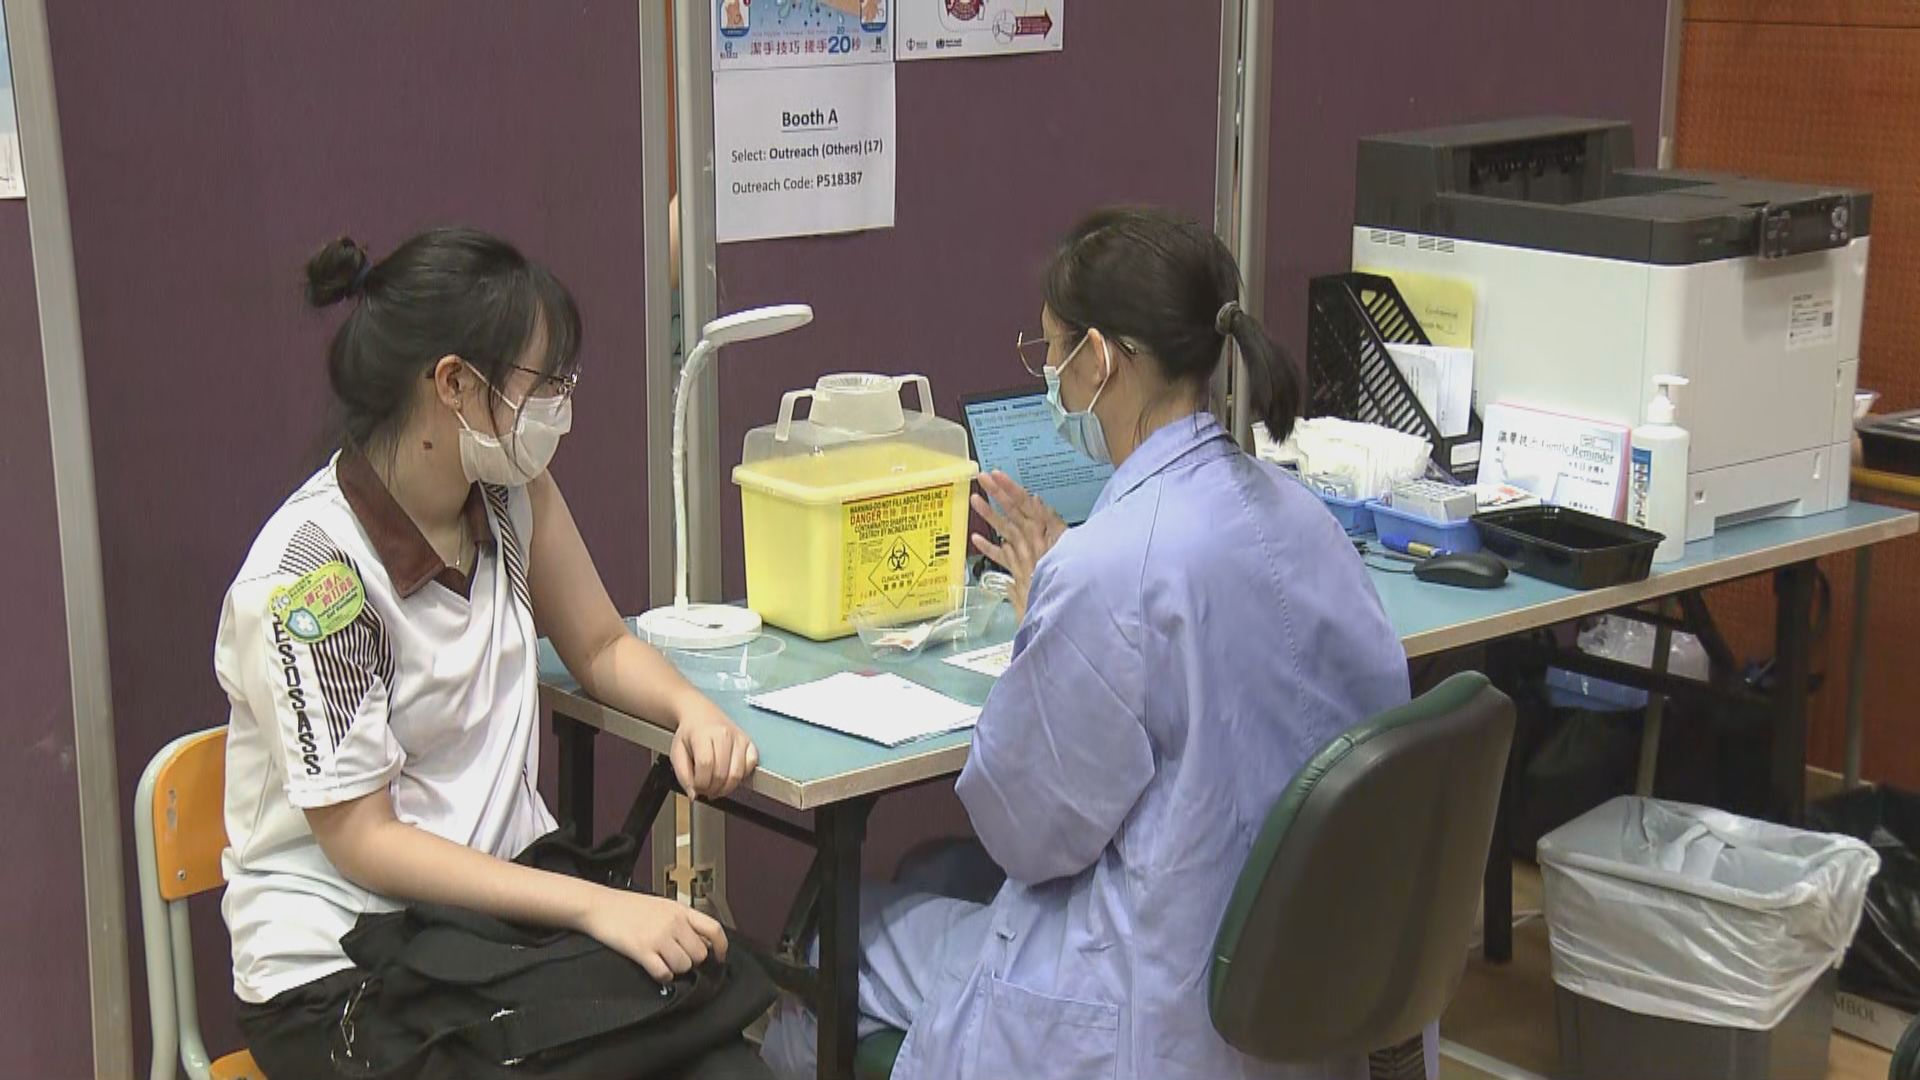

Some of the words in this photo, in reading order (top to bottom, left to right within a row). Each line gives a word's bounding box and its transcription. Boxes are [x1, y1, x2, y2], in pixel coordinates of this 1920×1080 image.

[782, 109, 824, 127] Booth
[828, 108, 839, 124] A
[732, 150, 767, 163] Select:
[769, 144, 819, 160] Outreach
[822, 140, 862, 159] (Others)
[864, 137, 883, 155] (17)
[732, 178, 780, 195] Outreach
[783, 176, 814, 191] Code:
[816, 171, 863, 187] P518387
[1572, 444, 1614, 465] Reminder
[850, 510, 881, 525] DANGER
